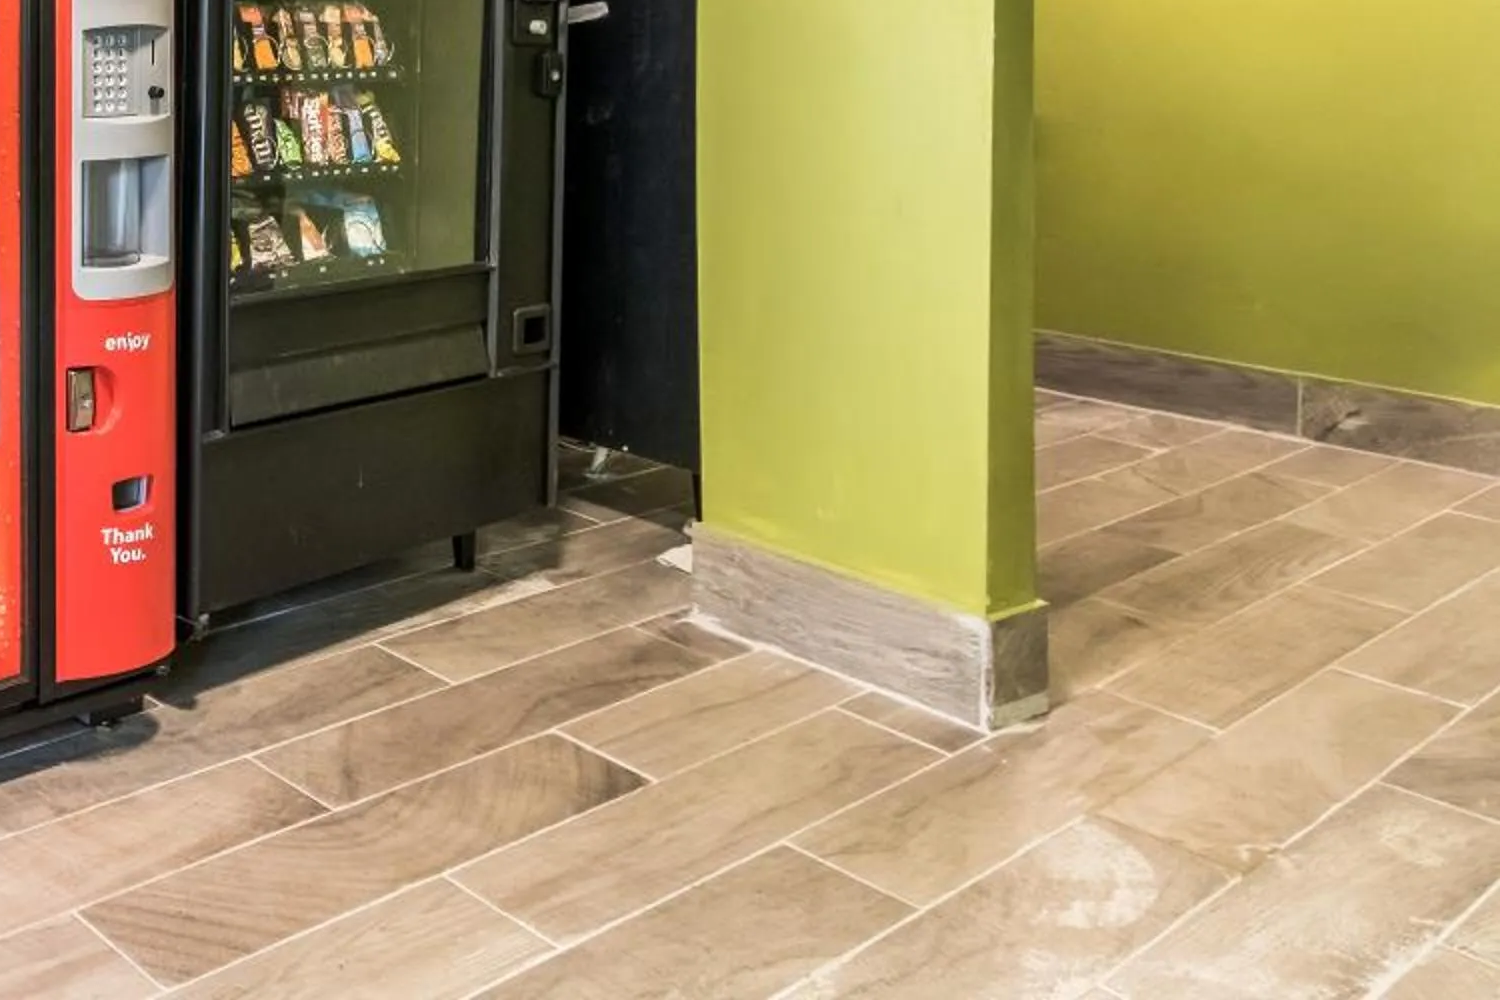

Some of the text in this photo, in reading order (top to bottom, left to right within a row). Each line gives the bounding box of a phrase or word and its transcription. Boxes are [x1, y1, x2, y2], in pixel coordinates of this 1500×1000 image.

[104, 331, 151, 352] enjoy
[101, 522, 153, 545] Thank
[110, 547, 147, 564] You.
